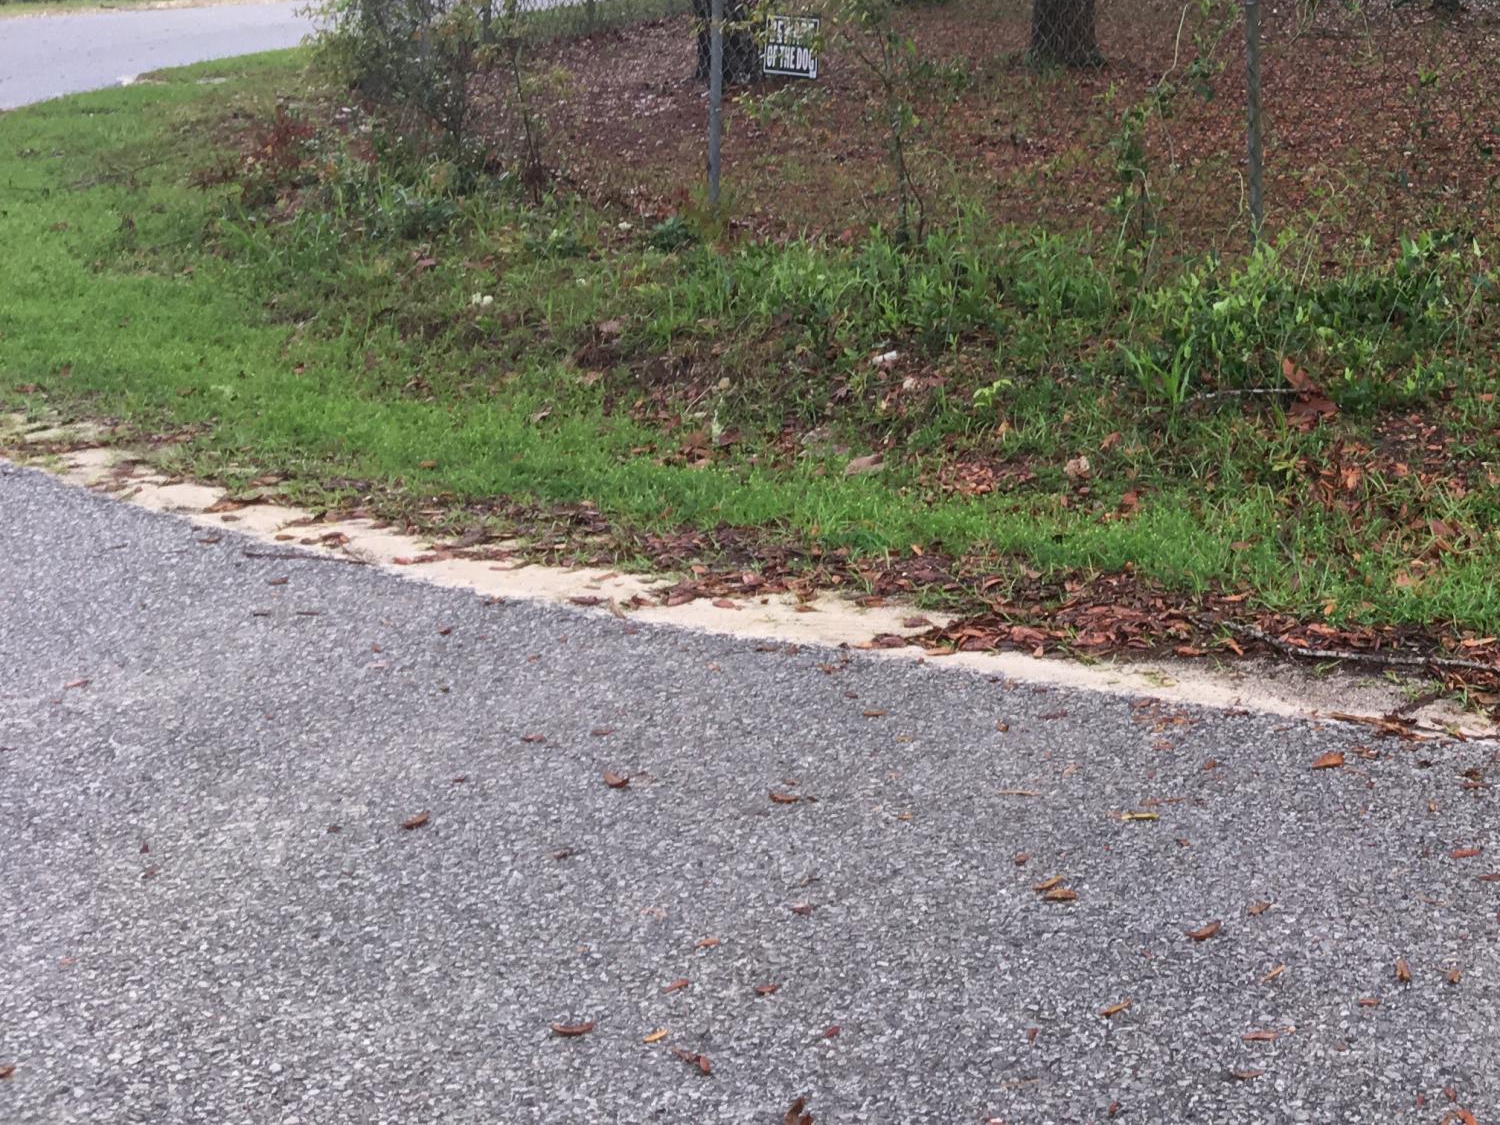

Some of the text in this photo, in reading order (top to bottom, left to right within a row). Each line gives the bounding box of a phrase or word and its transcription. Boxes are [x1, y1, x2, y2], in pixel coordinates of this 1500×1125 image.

[767, 45, 815, 71] OF THE DOG
